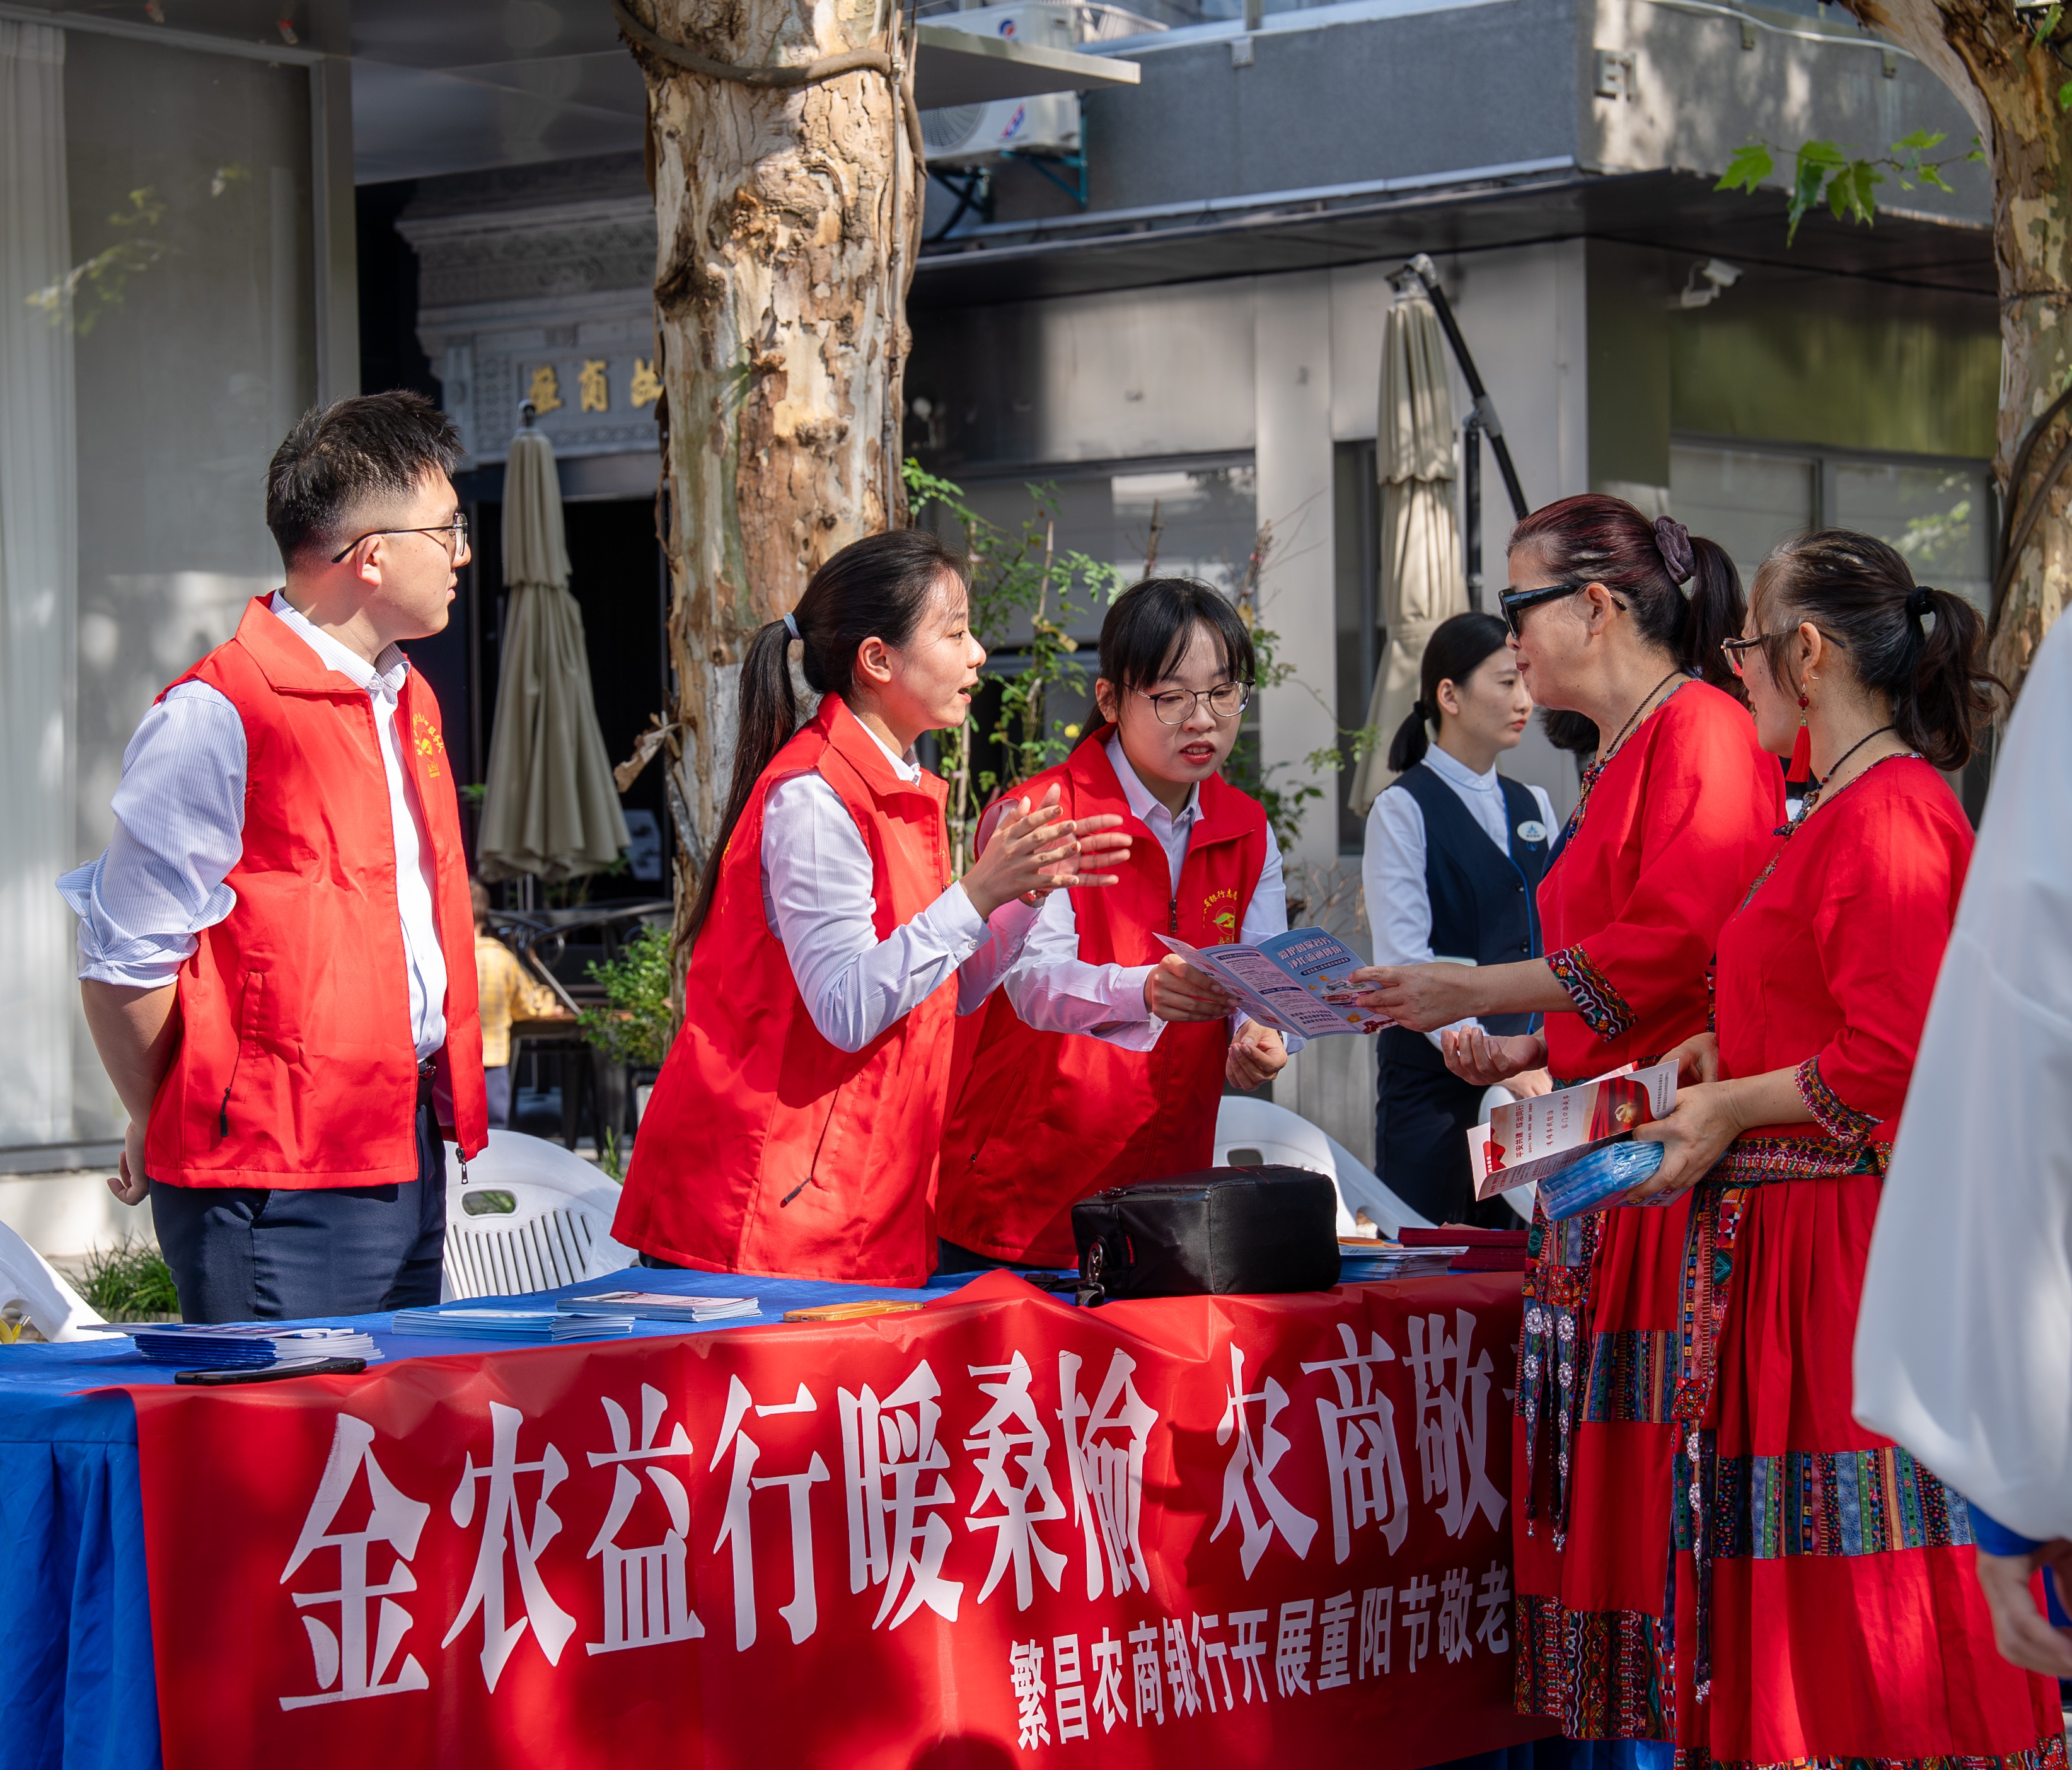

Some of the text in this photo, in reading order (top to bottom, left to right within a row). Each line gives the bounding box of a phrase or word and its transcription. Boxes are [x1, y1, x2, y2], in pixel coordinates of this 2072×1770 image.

[1276, 937, 1333, 960] 爱护国家名片
[1287, 945, 1345, 969] 净化流通环境
[1515, 1132, 1524, 1158] 平安共建
[279, 1308, 1519, 1712] 金农益行暖桑榆 农商敬
[1009, 1560, 1510, 1751] 繁昌农商银行开展重阳节敬老
